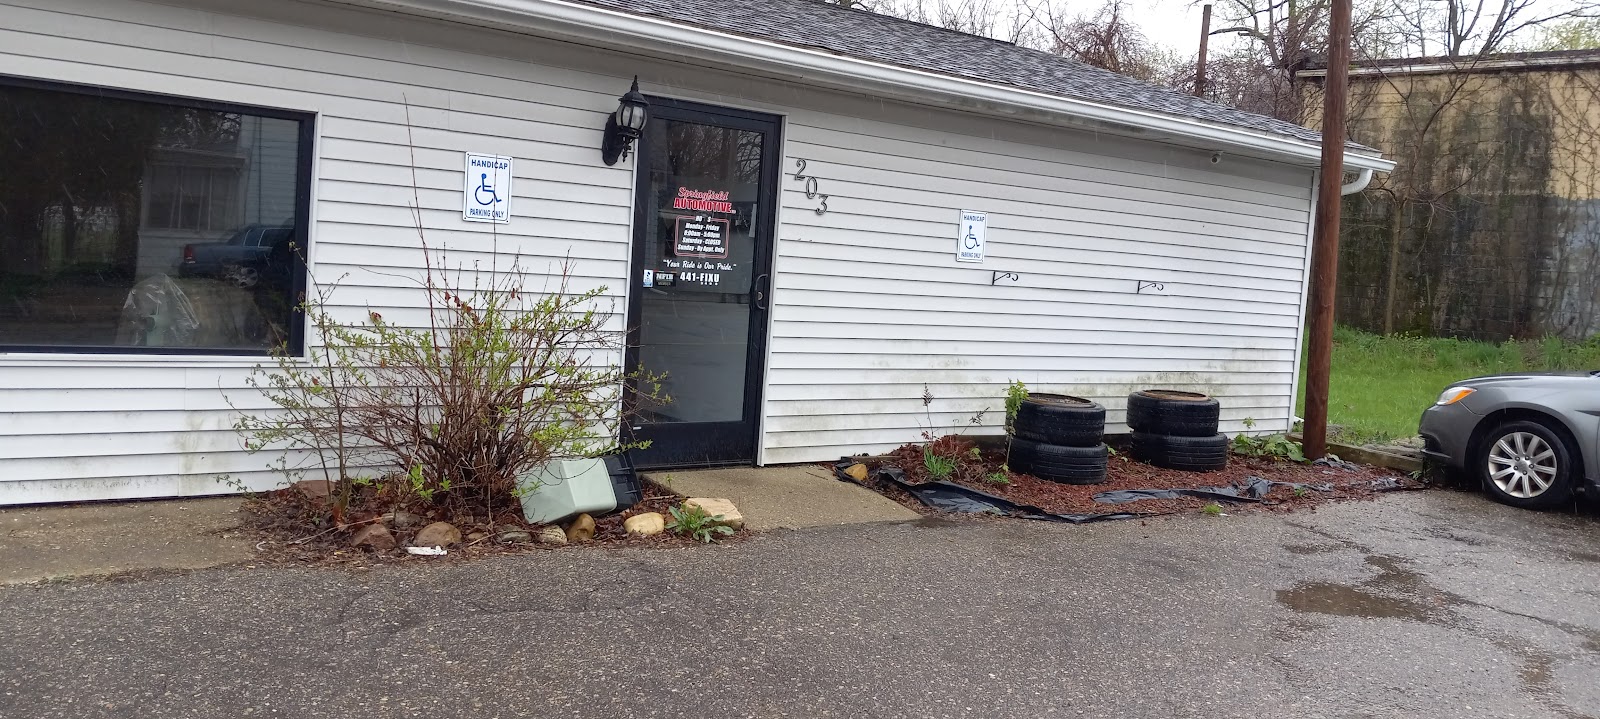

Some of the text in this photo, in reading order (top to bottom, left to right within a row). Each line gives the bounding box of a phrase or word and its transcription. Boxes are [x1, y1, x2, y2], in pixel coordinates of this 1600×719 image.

[471, 159, 508, 170] HANDICAP
[794, 158, 829, 215] 203
[678, 186, 729, 201] Springfield
[673, 197, 732, 213] AUTOMOTIVE
[470, 208, 504, 218] PARKING ONLY
[683, 260, 695, 269] Ride
[704, 261, 715, 270] Our
[680, 272, 720, 283] 441-FIXU
